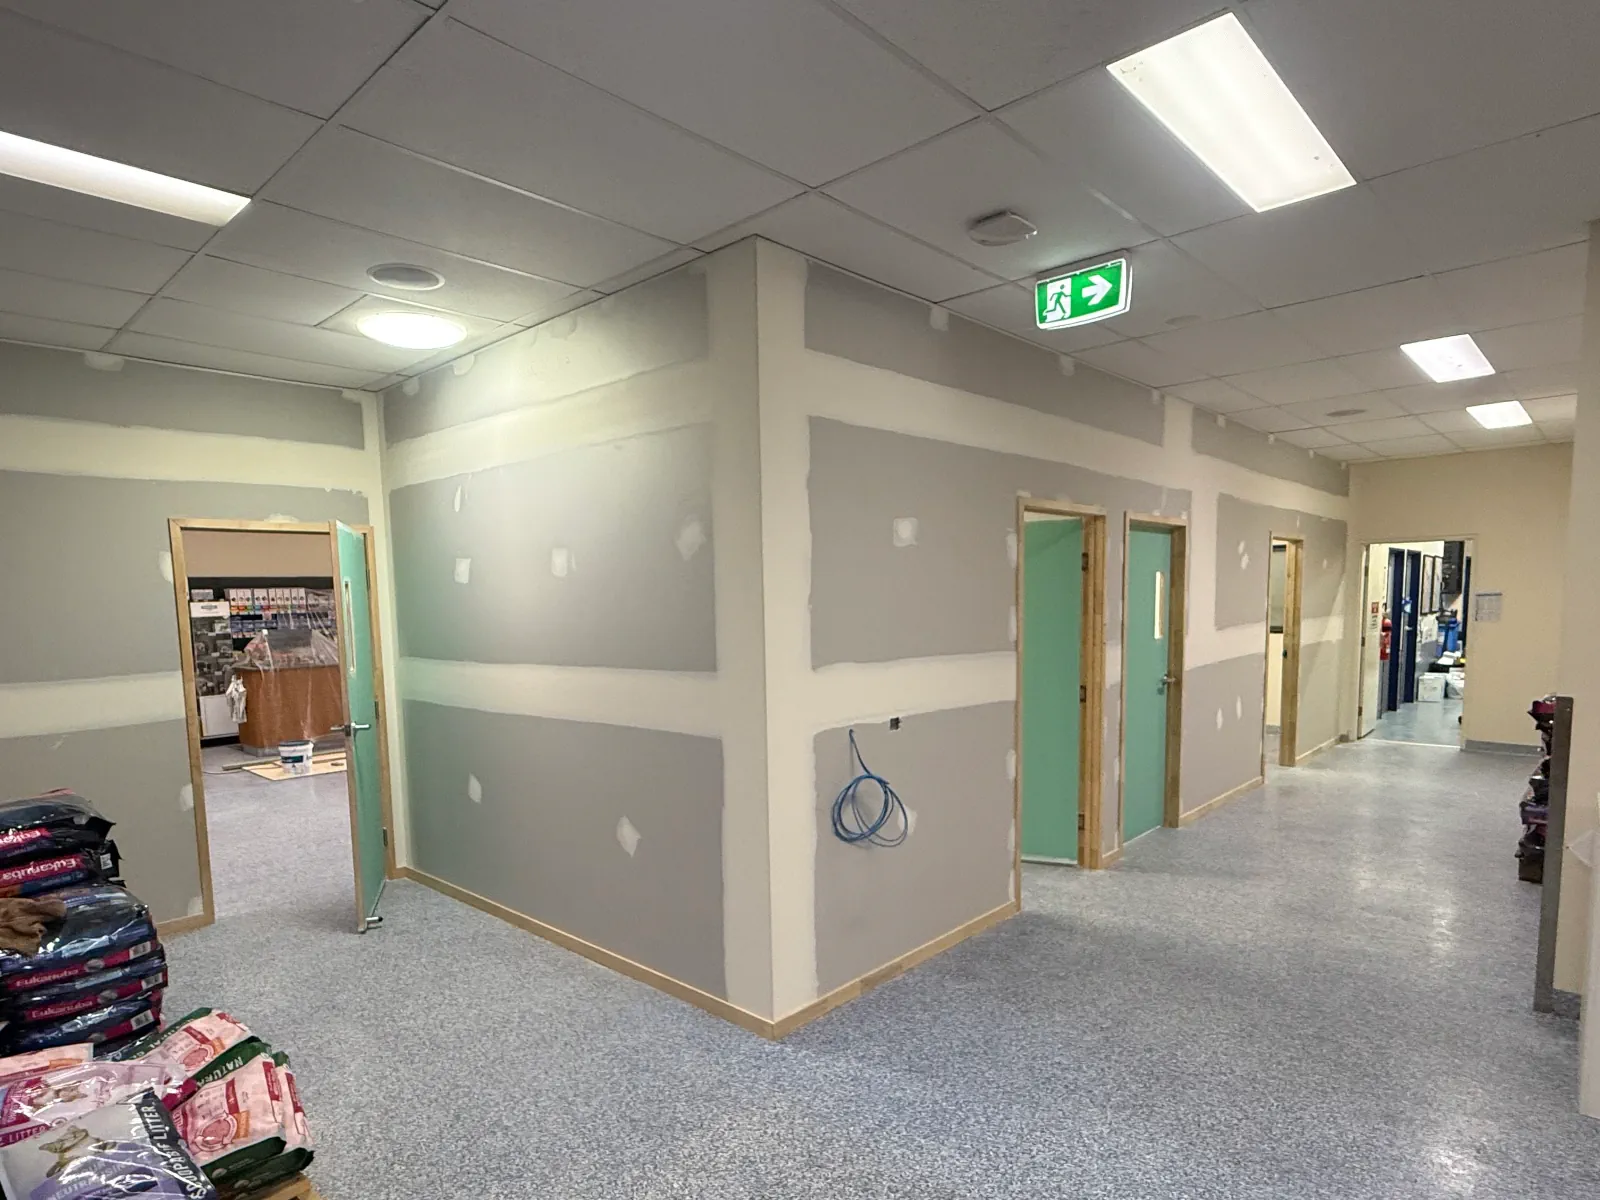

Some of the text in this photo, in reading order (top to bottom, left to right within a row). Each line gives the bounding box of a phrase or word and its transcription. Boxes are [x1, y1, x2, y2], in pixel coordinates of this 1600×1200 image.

[2, 858, 77, 880] Eukanuba
[15, 968, 79, 987] Eukanuba
[31, 1001, 93, 1018] Eukanuba
[196, 1056, 244, 1088] NATURA
